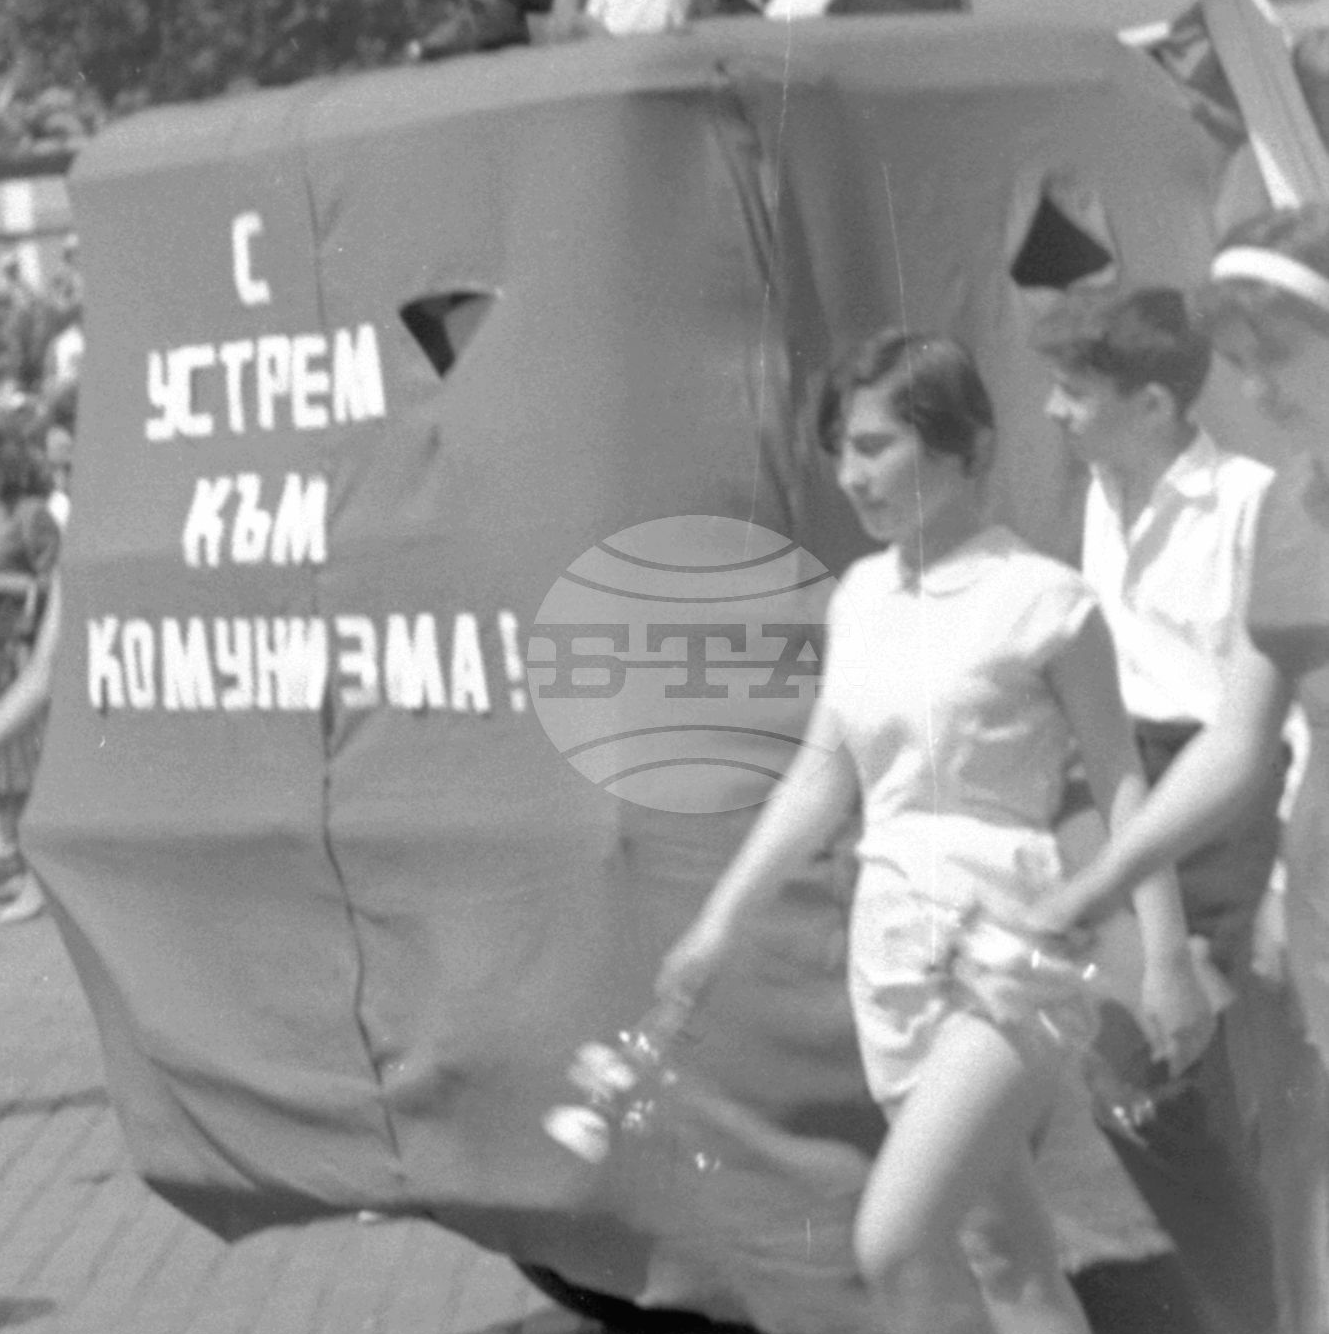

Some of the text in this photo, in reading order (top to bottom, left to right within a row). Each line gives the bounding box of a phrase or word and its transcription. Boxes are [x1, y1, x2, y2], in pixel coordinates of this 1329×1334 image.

[232, 211, 271, 305] С
[146, 323, 386, 441] УСТРЕМ
[183, 472, 328, 567] КЪМ
[87, 610, 527, 712] КОМУНИЗМА!
